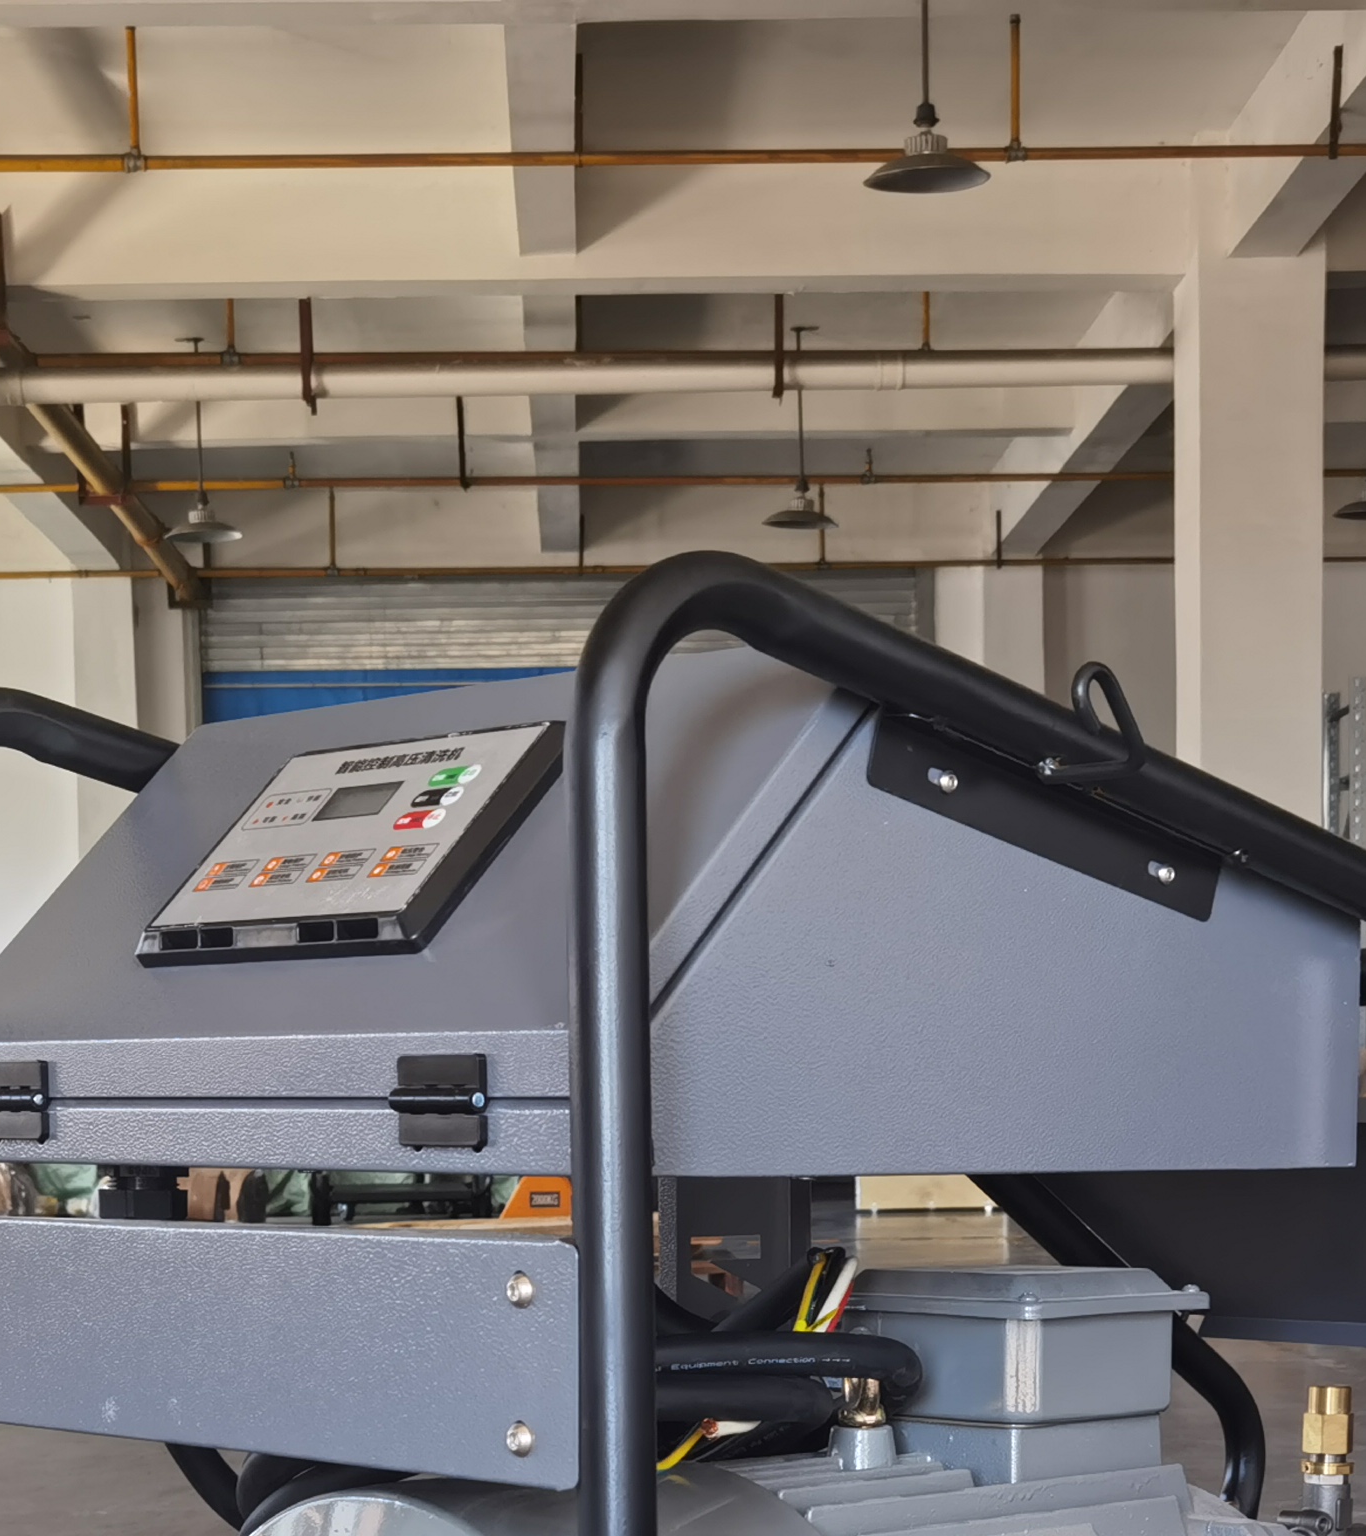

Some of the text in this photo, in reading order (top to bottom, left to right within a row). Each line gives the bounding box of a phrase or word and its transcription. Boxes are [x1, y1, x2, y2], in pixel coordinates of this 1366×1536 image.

[335, 747, 465, 775] 智能控制高压清洗机
[670, 1359, 740, 1371] Equipment
[747, 1356, 816, 1366] Connection
